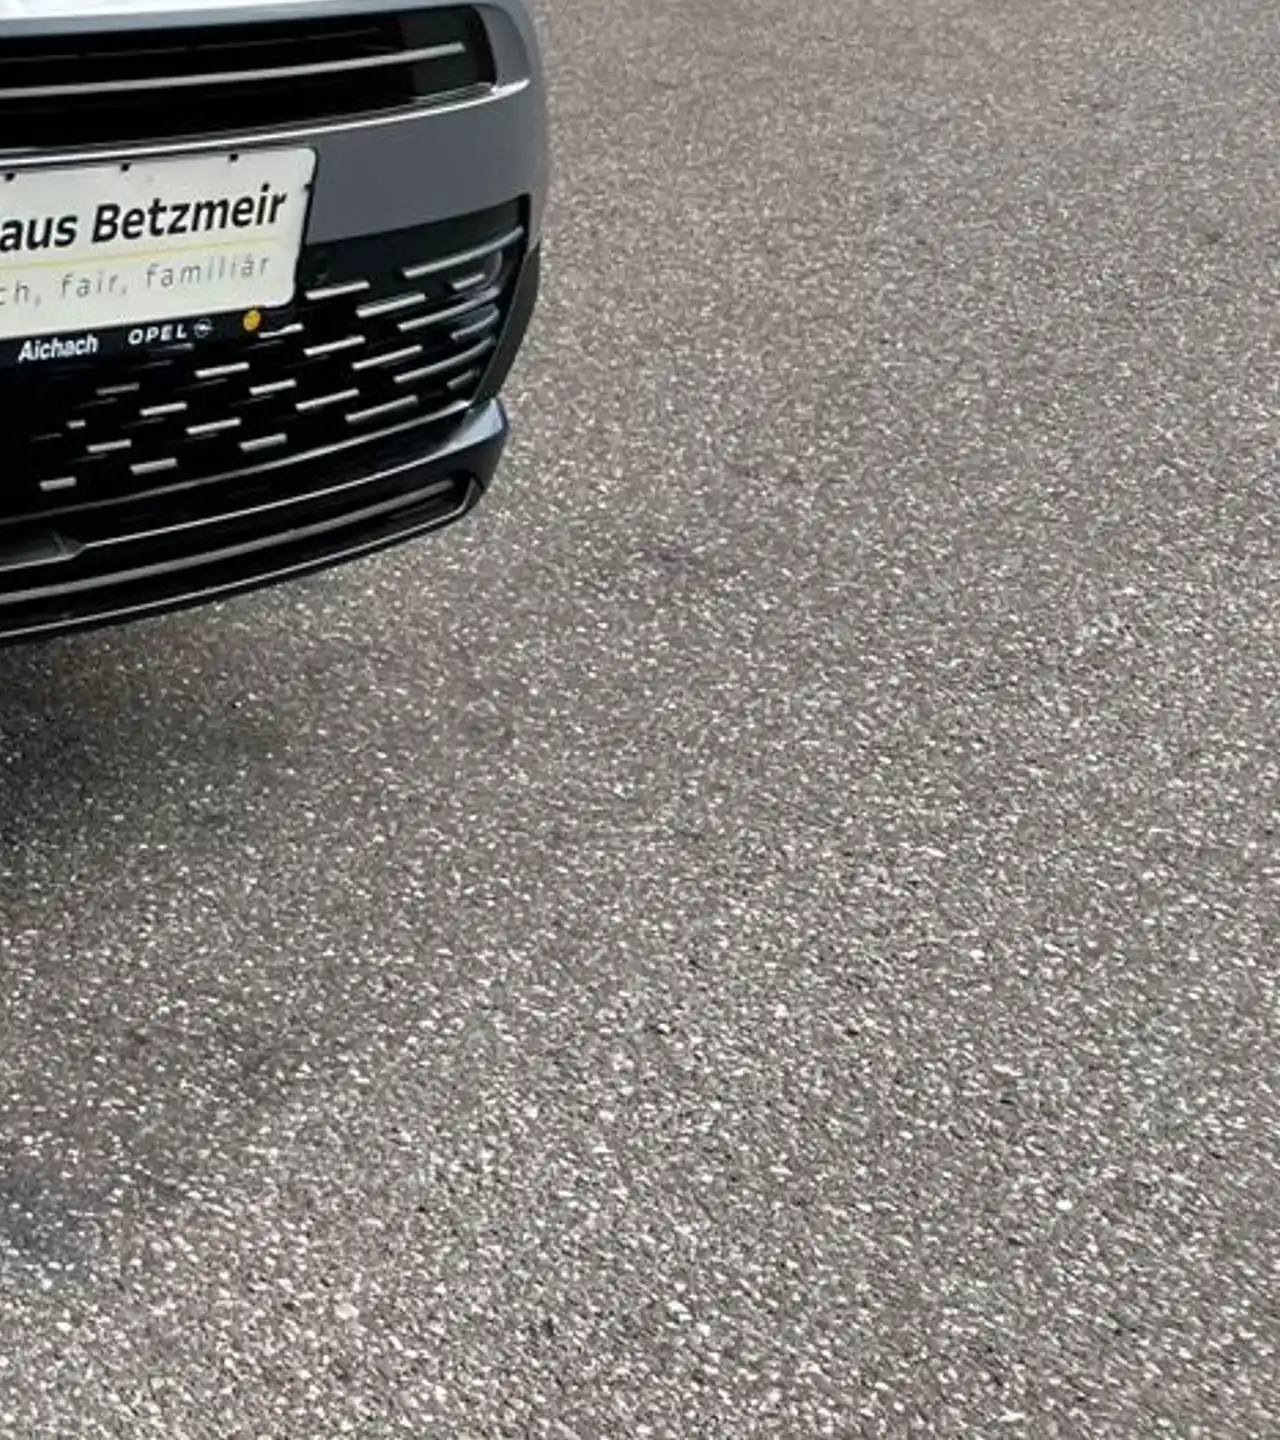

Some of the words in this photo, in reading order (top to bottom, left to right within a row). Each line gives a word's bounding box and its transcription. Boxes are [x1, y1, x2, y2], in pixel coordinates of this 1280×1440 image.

[92, 182, 288, 245] Betzmeir
[60, 272, 129, 300] fair,
[17, 333, 100, 363] Aichach
[127, 322, 189, 346] OPEL
